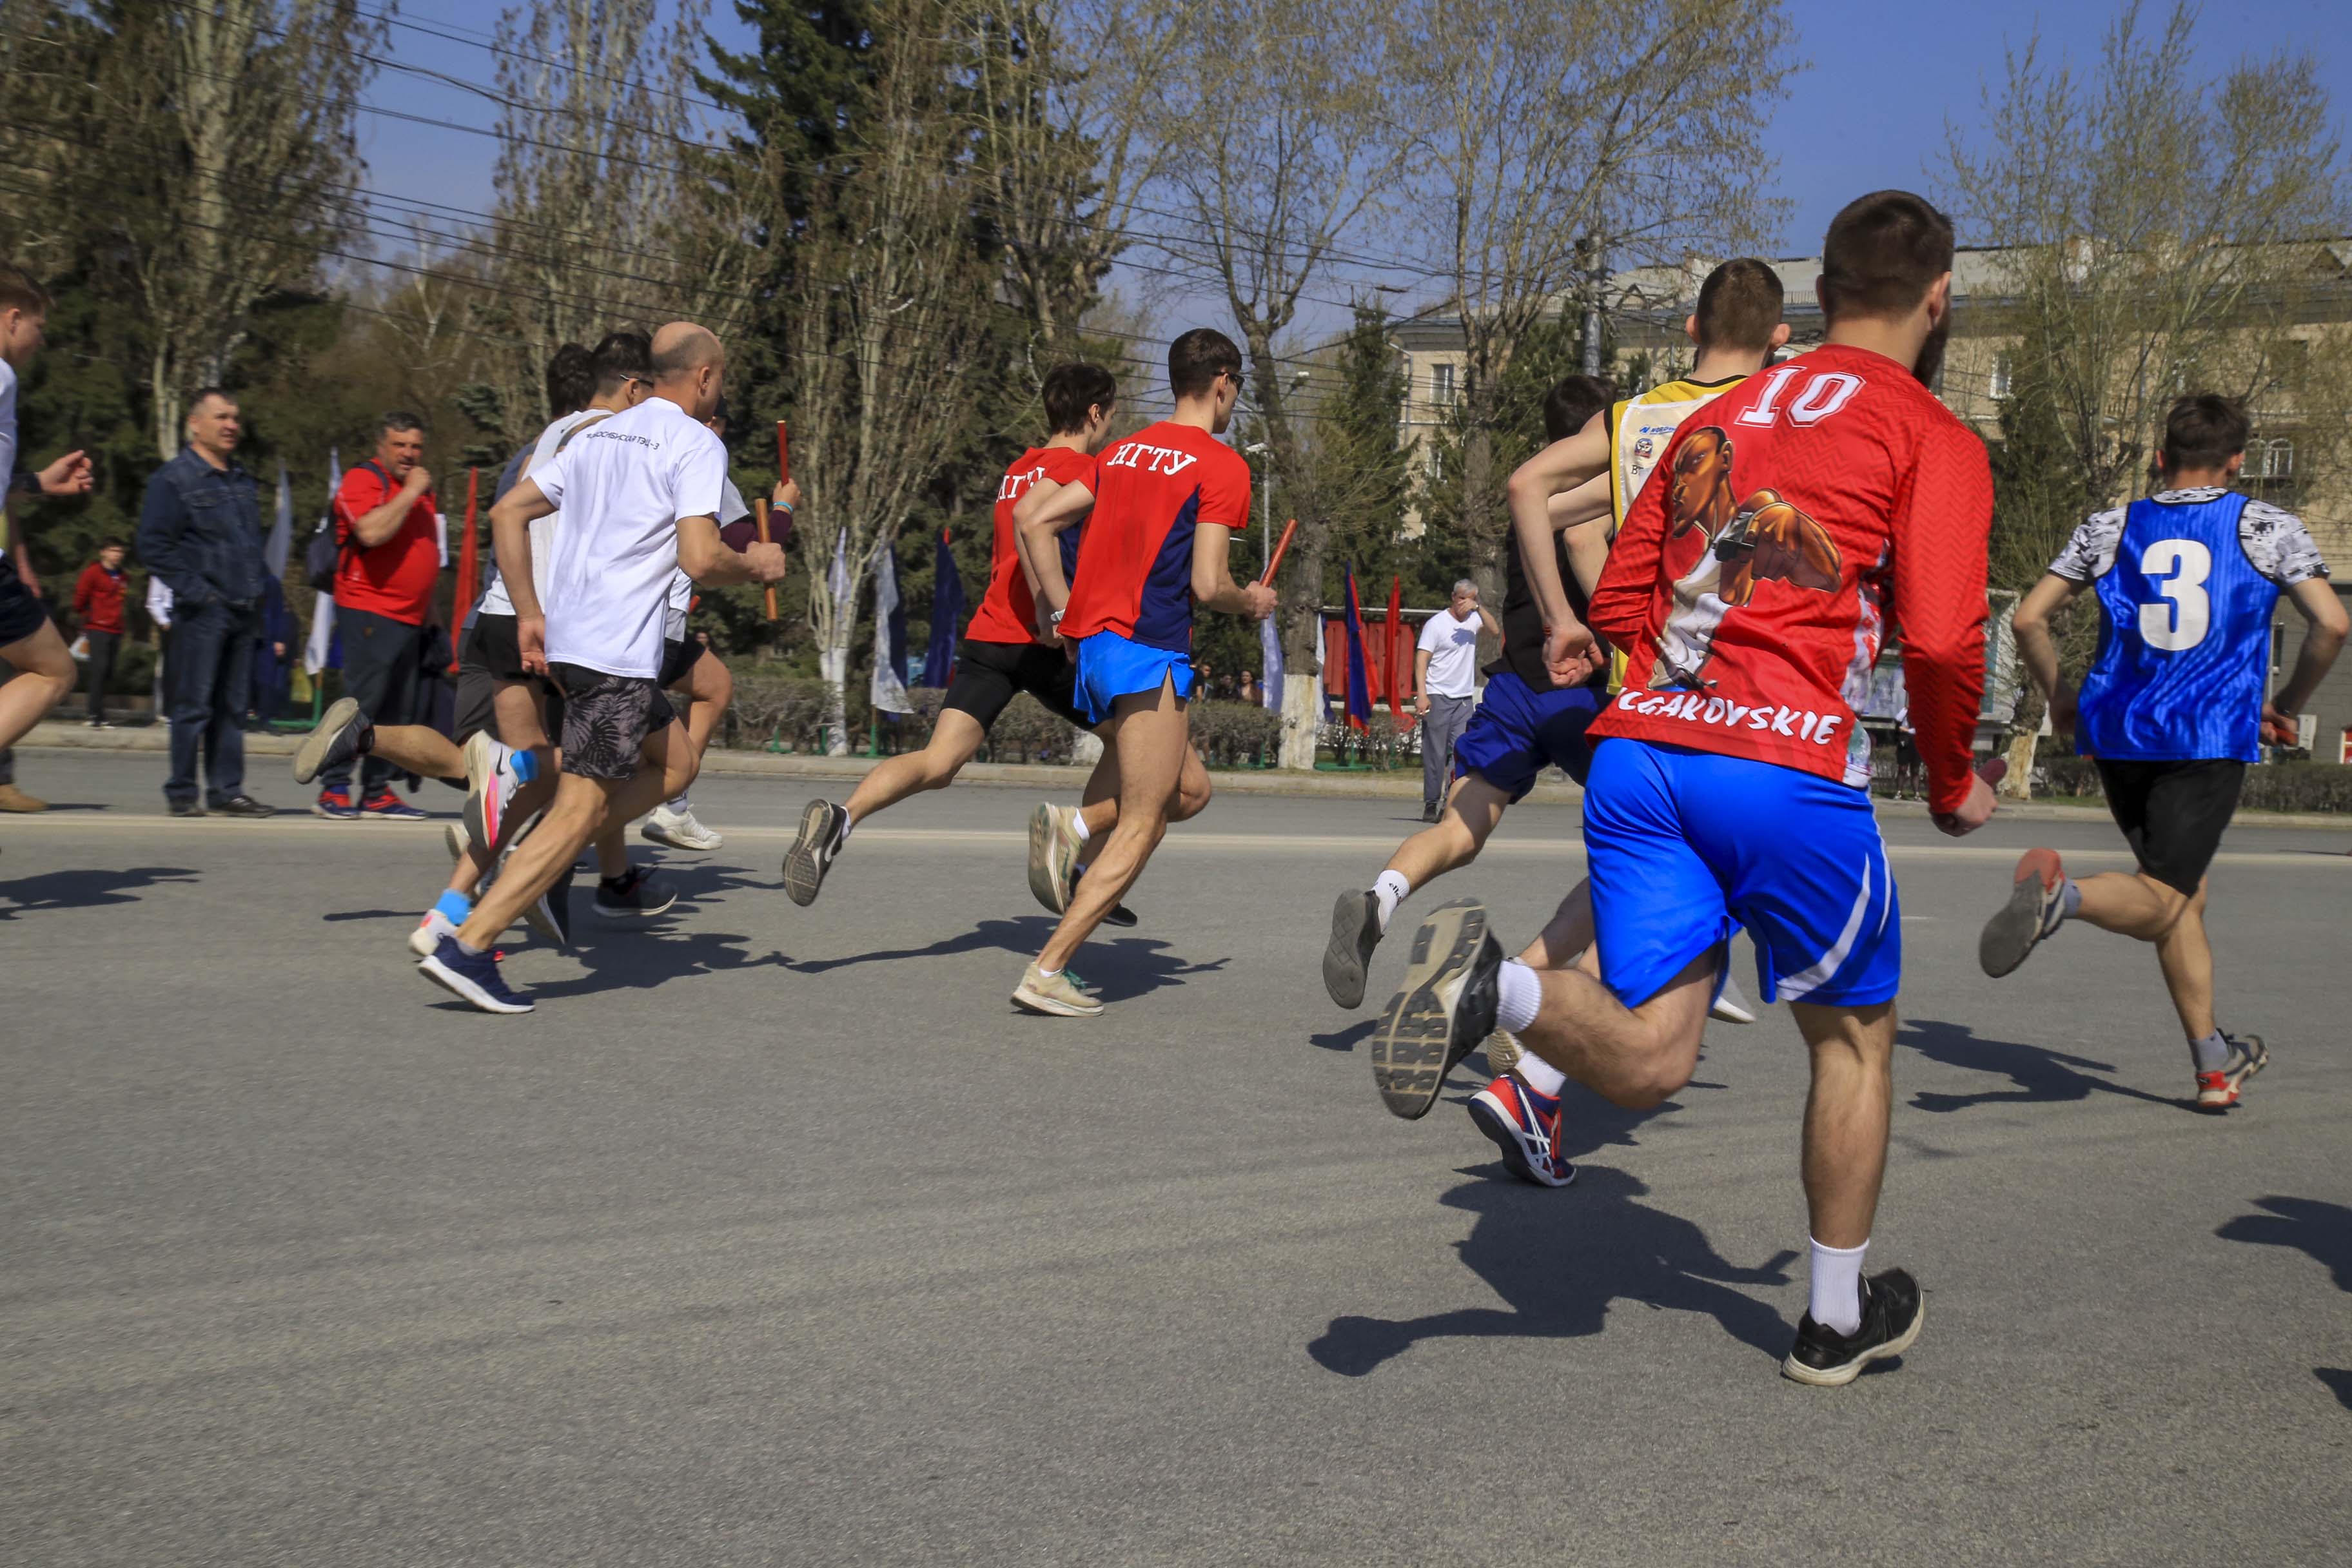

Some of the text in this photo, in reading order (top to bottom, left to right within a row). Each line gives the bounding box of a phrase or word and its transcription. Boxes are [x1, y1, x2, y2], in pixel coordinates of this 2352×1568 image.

[1734, 365, 1867, 429] 10
[1106, 442, 1197, 476] НГТУ
[2138, 538, 2212, 651] 3
